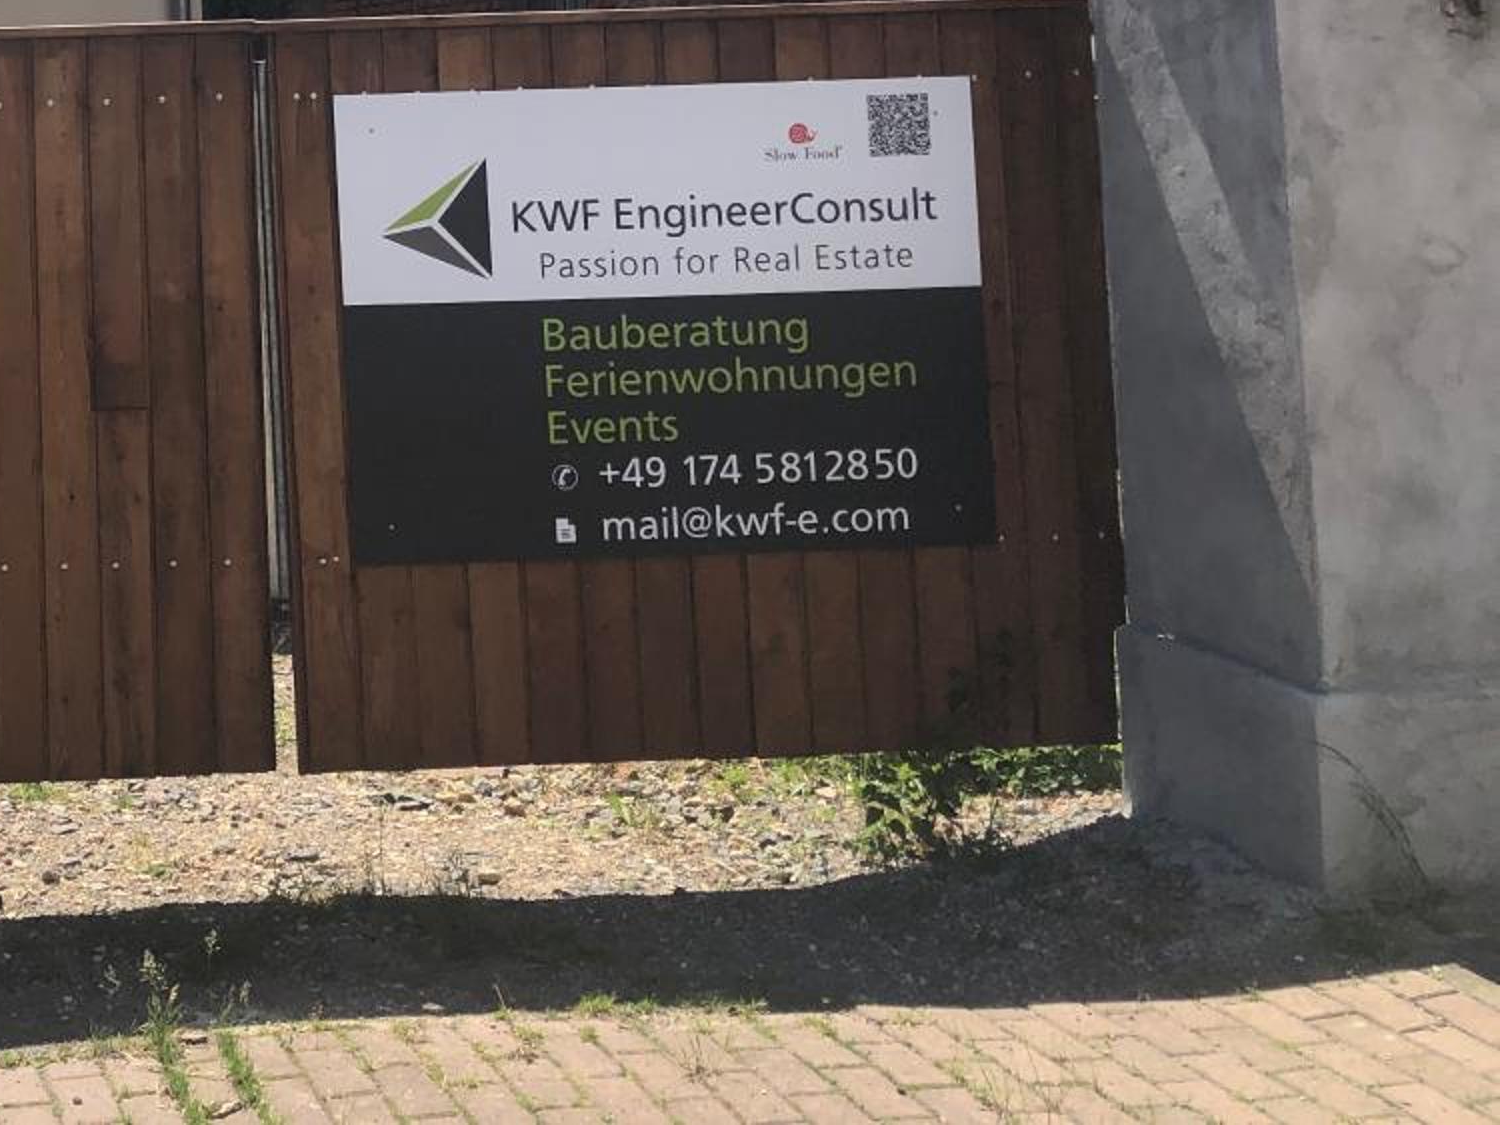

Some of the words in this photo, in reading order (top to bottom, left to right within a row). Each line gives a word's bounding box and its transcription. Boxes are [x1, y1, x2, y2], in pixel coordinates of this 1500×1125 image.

[512, 199, 599, 232] KWF
[615, 187, 937, 237] EngineerConsult
[540, 250, 658, 278] Passion
[675, 247, 719, 274] for
[735, 244, 799, 272] Real
[816, 245, 912, 270] Estate
[543, 314, 807, 353] Bauberatung
[546, 357, 916, 397] Ferienwohnungen
[548, 411, 678, 444] Events
[600, 457, 665, 487] +49
[684, 455, 741, 485] 174
[756, 448, 917, 483] 5812850
[603, 502, 908, 540] mail@kwf-e.com
